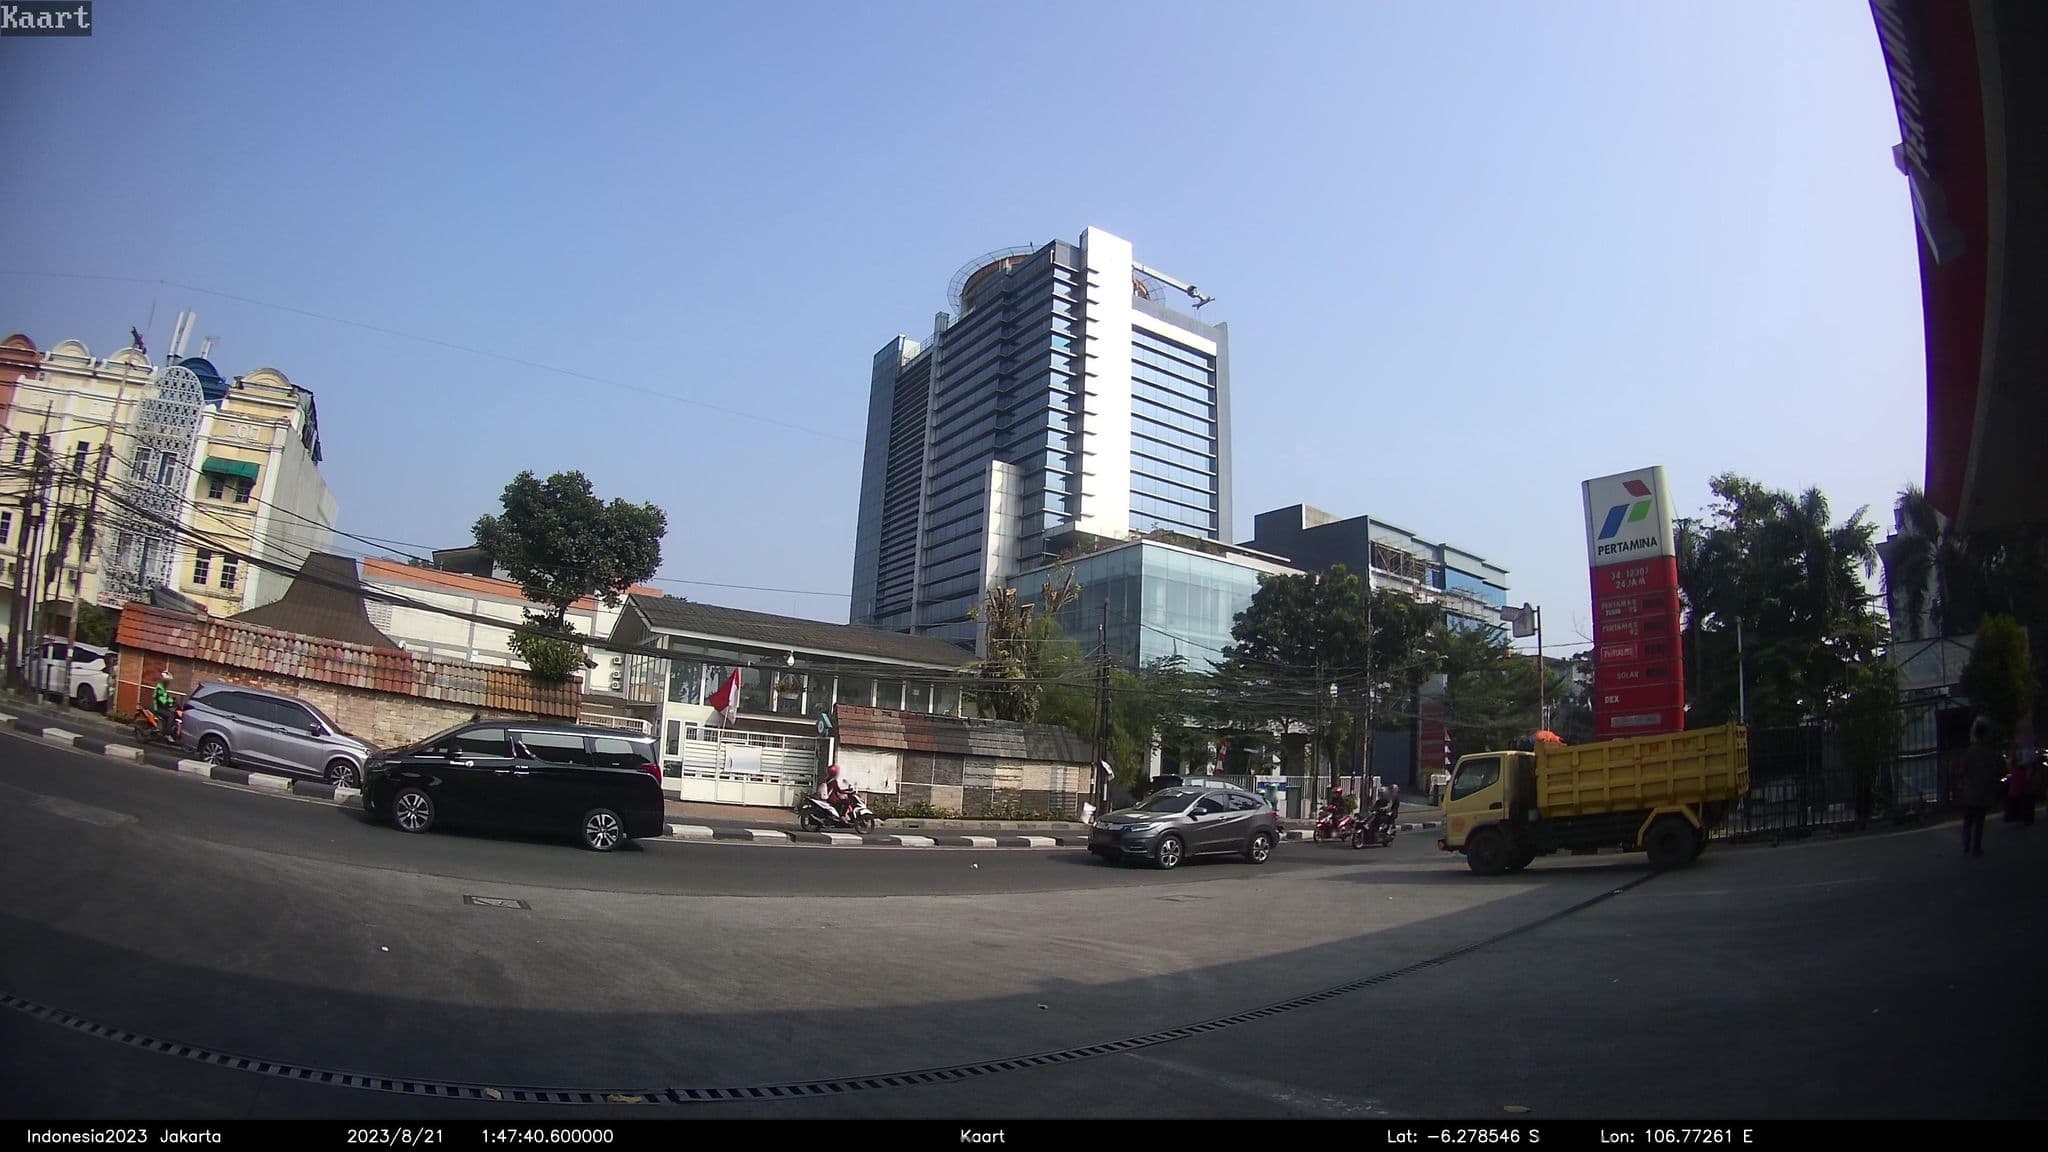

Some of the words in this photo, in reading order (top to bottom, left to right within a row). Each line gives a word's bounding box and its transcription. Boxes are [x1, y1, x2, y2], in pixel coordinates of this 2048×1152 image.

[1598, 536, 1658, 556] PERTAMINA
[1616, 671, 1639, 680] SOLAR
[1604, 695, 1620, 704] DEX
